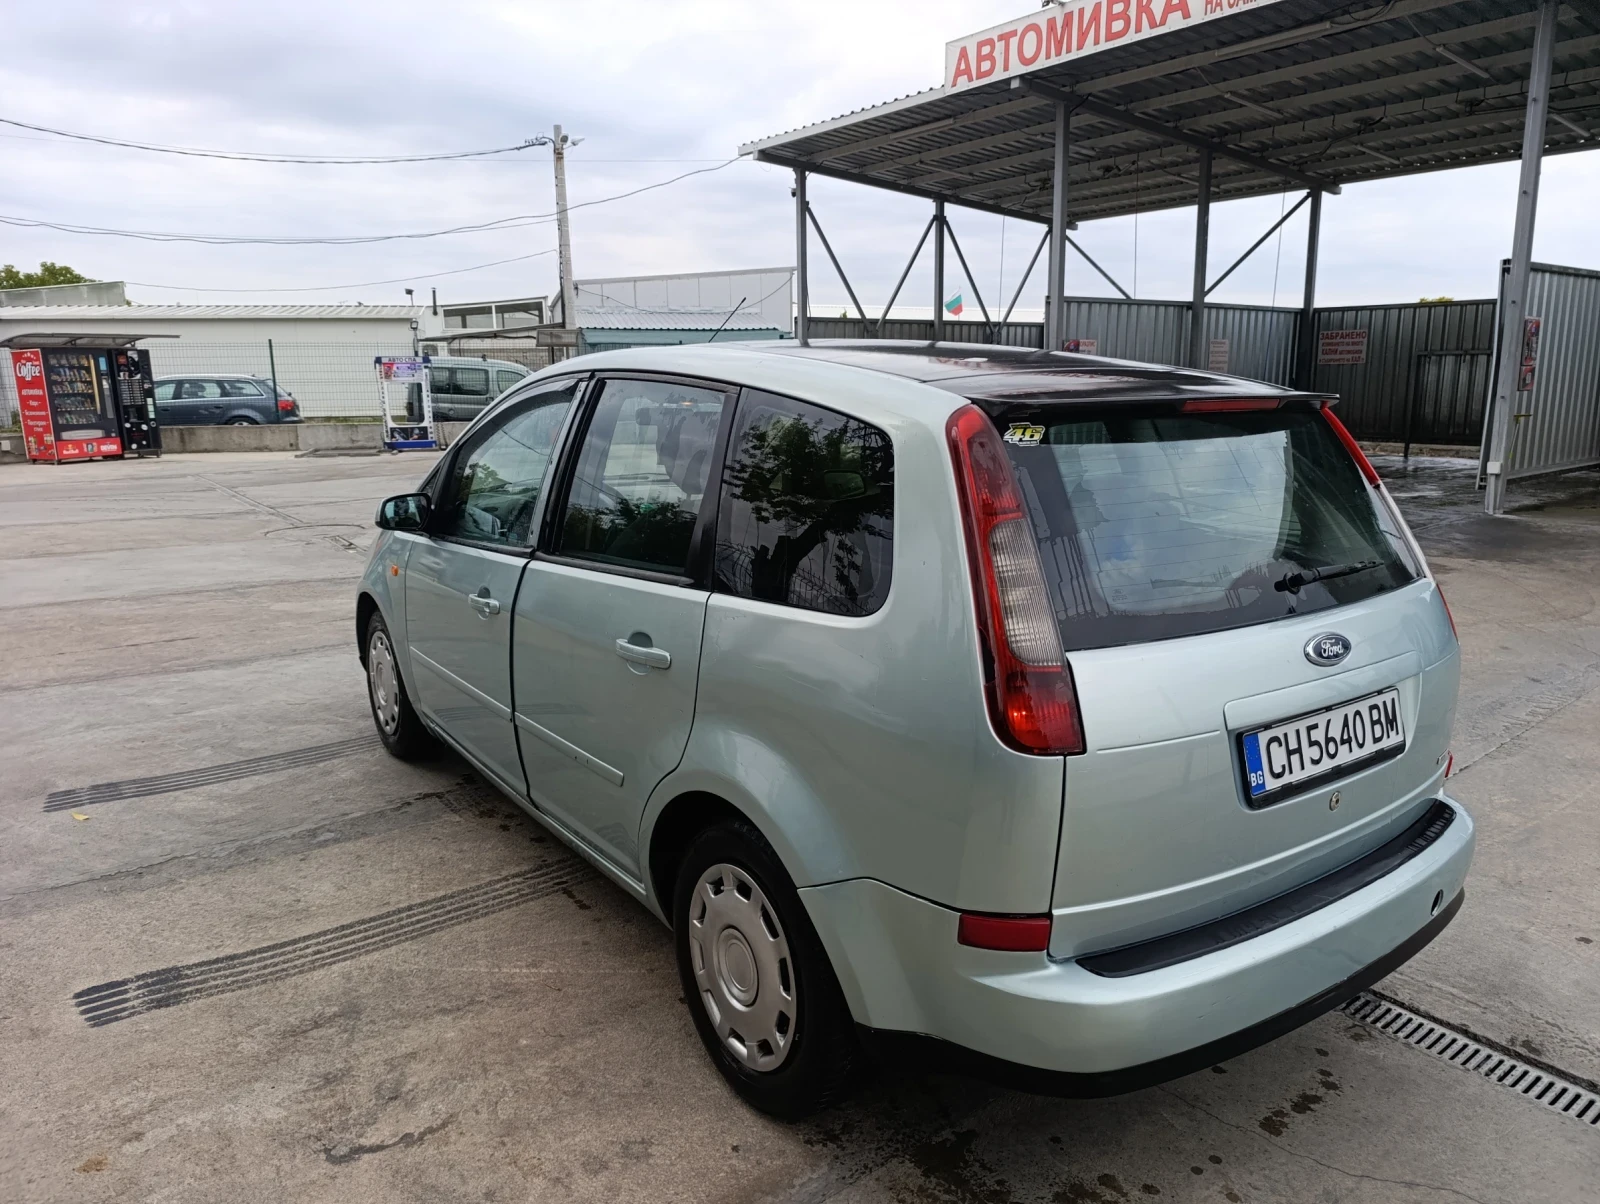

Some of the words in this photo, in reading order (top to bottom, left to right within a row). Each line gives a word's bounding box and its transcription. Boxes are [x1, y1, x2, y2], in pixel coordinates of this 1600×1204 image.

[951, 0, 1191, 88] АВТОМИВКА
[1320, 331, 1367, 340] ЗАБРАНЕНО
[16, 362, 41, 380] Coffee
[1004, 428, 1042, 441] 46
[1321, 639, 1344, 657] Ford
[1250, 770, 1264, 787] BG
